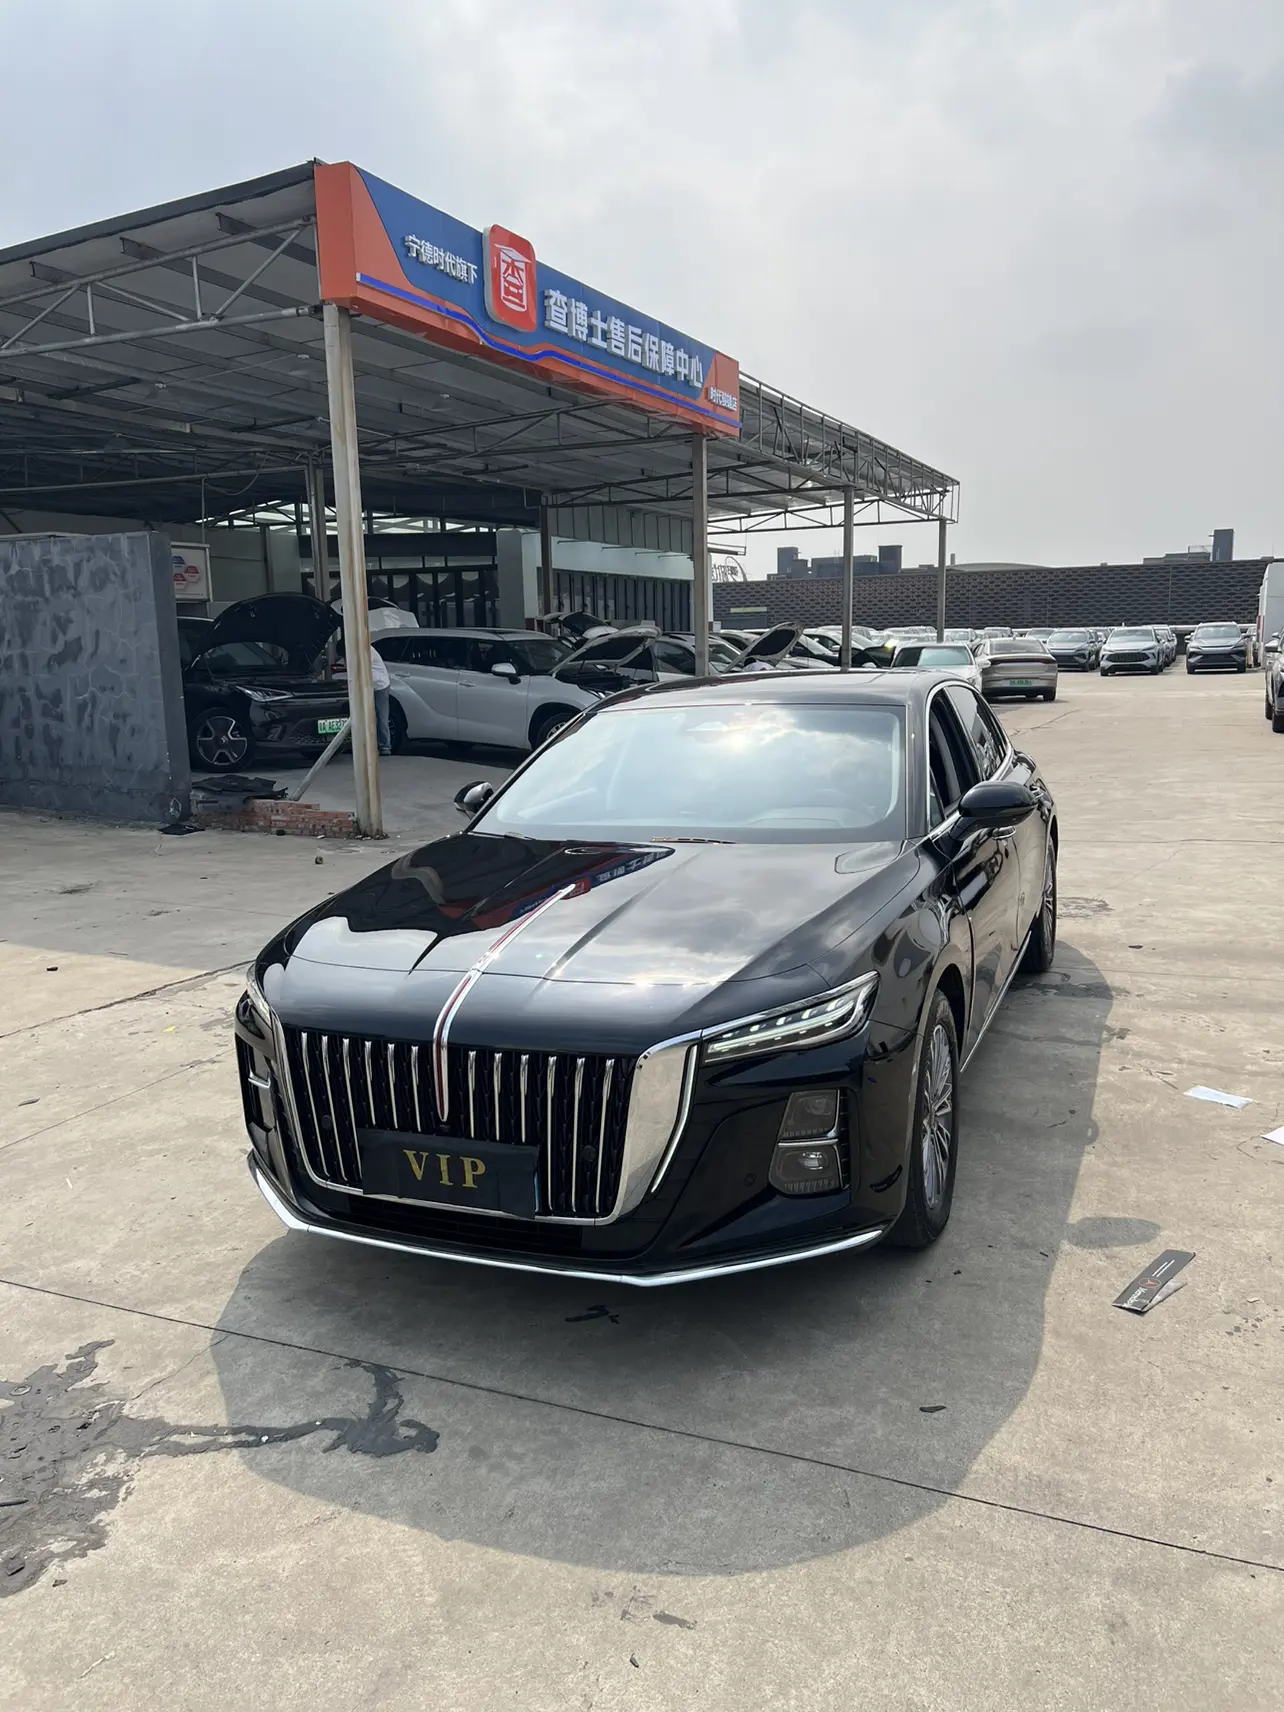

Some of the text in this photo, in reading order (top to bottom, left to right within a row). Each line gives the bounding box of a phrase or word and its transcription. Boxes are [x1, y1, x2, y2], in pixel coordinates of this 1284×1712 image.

[405, 234, 478, 285] 宁德时代旗下
[545, 288, 703, 388] 查博士售后保障中心
[403, 1149, 486, 1188] VIP
